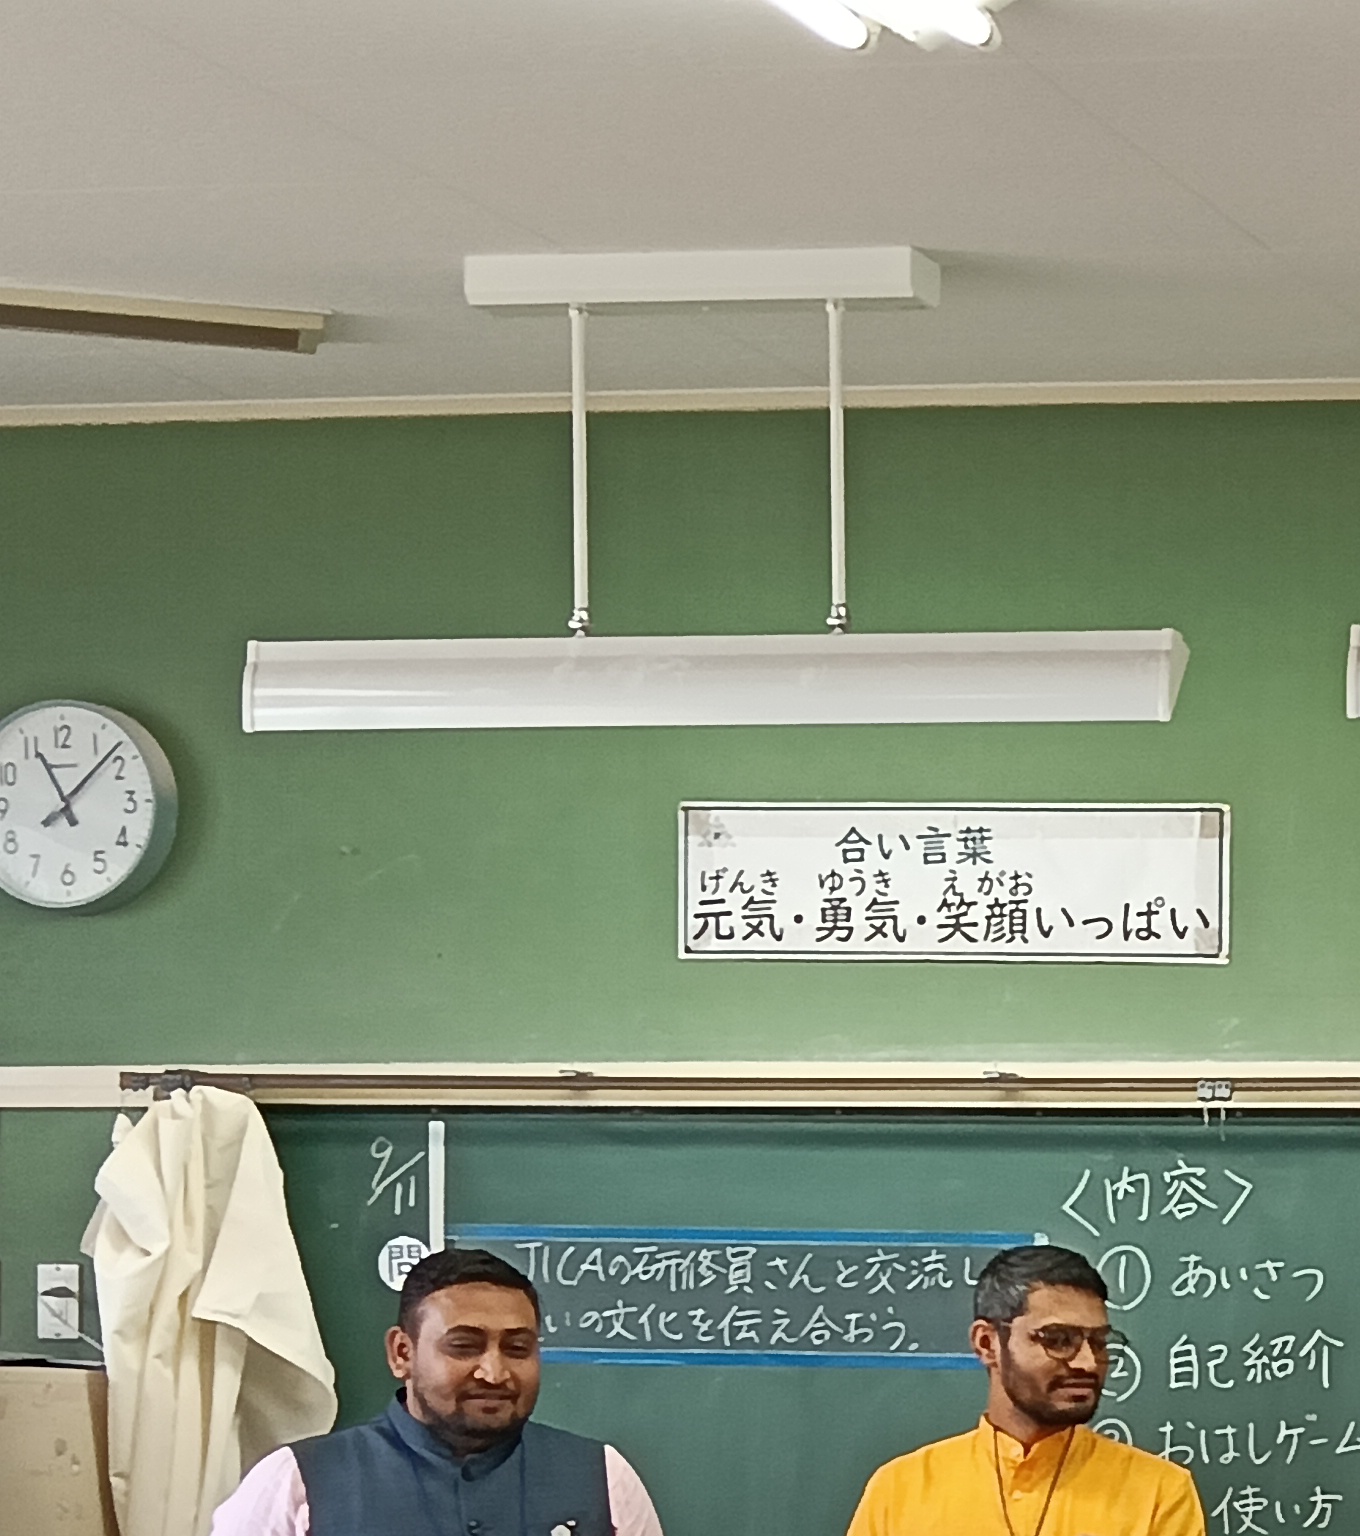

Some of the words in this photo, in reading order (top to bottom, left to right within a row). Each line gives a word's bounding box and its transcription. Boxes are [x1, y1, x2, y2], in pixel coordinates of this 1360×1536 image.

[54, 724, 72, 749] 12
[112, 755, 125, 780] 2
[124, 790, 138, 814] 3
[3, 830, 19, 854] 8
[115, 825, 129, 847] 4
[834, 825, 995, 866] 合い言葉
[29, 853, 41, 878] 7
[60, 862, 76, 886] 6
[93, 850, 107, 875] 5
[699, 868, 781, 896] げんき
[817, 869, 893, 897] ゆうき
[942, 869, 1035, 898] えがお
[692, 895, 1211, 945] 元気・勇気・笑顔いっぱい
[1170, 1253, 1325, 1302] あいさつ
[536, 1304, 921, 1352] いの文化を伝え合おう。
[1169, 1329, 1345, 1390] 自己紹介
[1211, 1485, 1344, 1536] 使い方
